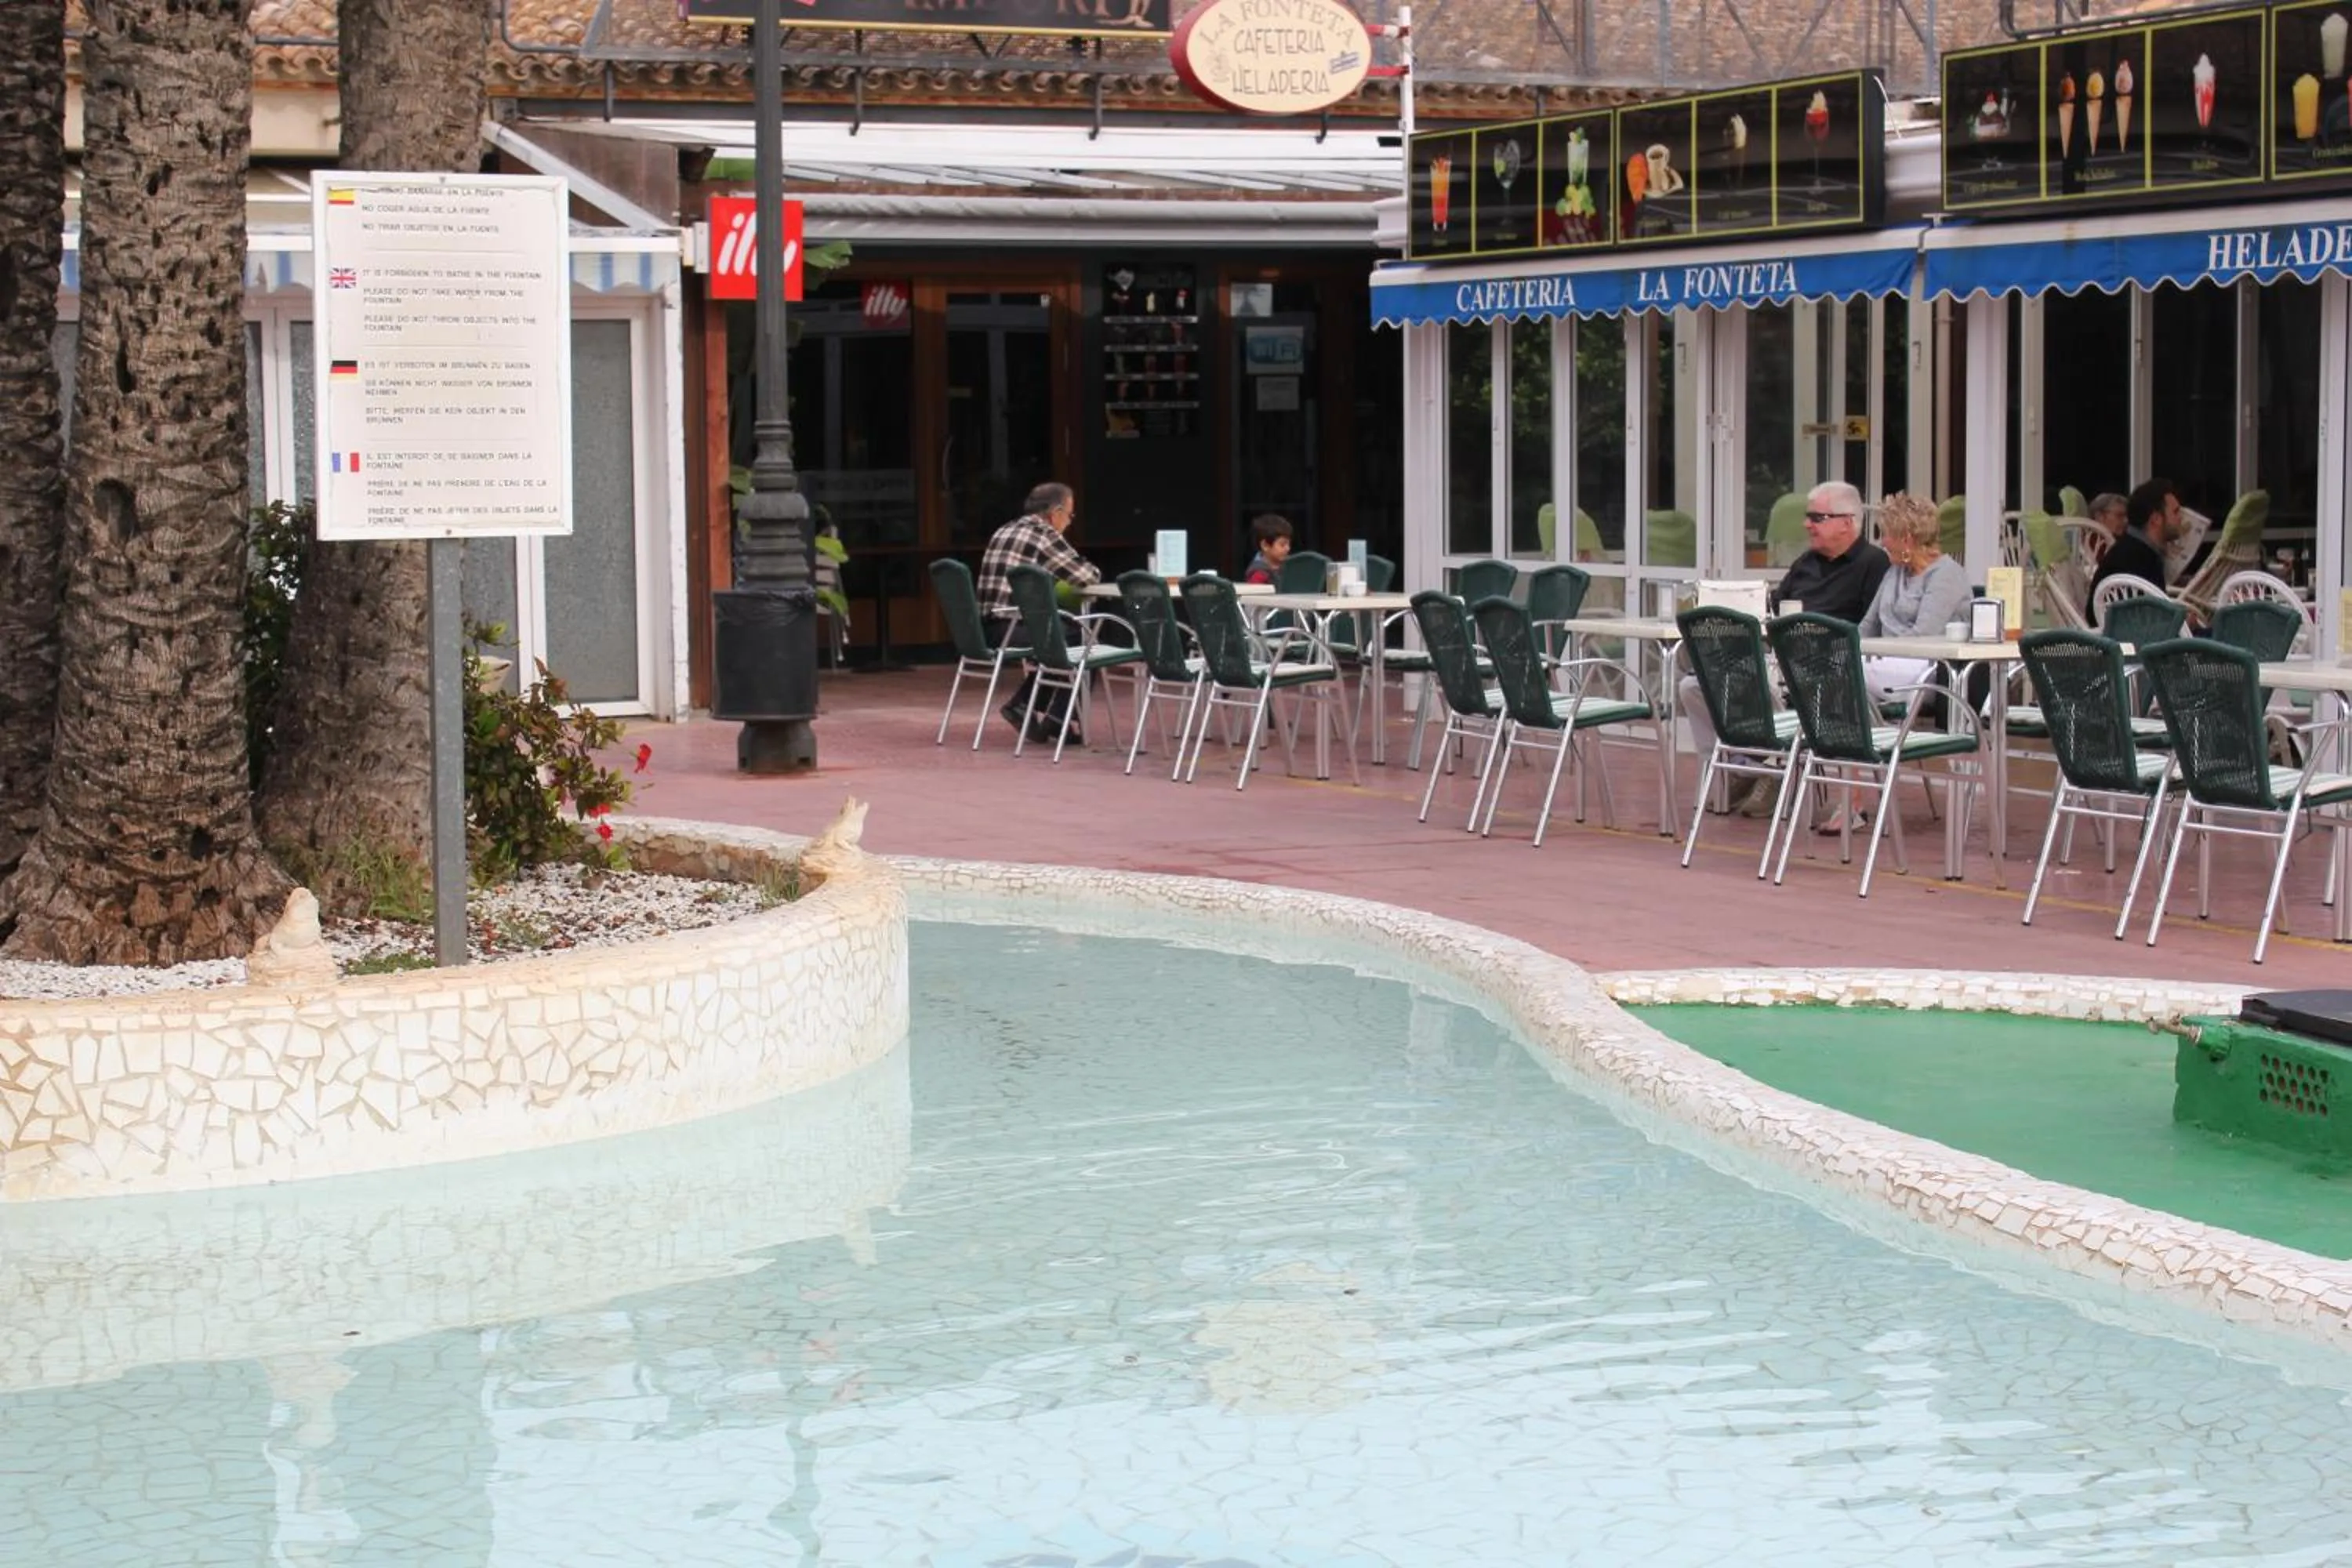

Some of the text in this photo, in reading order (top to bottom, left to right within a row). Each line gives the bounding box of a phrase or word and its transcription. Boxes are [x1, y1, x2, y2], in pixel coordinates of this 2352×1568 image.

[1200, 0, 1356, 47] LA FONTETA
[1232, 28, 1325, 59] CAFETERIA
[1232, 65, 1330, 96] HELADERIA
[865, 284, 907, 323] illy
[1456, 261, 1798, 312] CAFETERIA LA FONTETA
